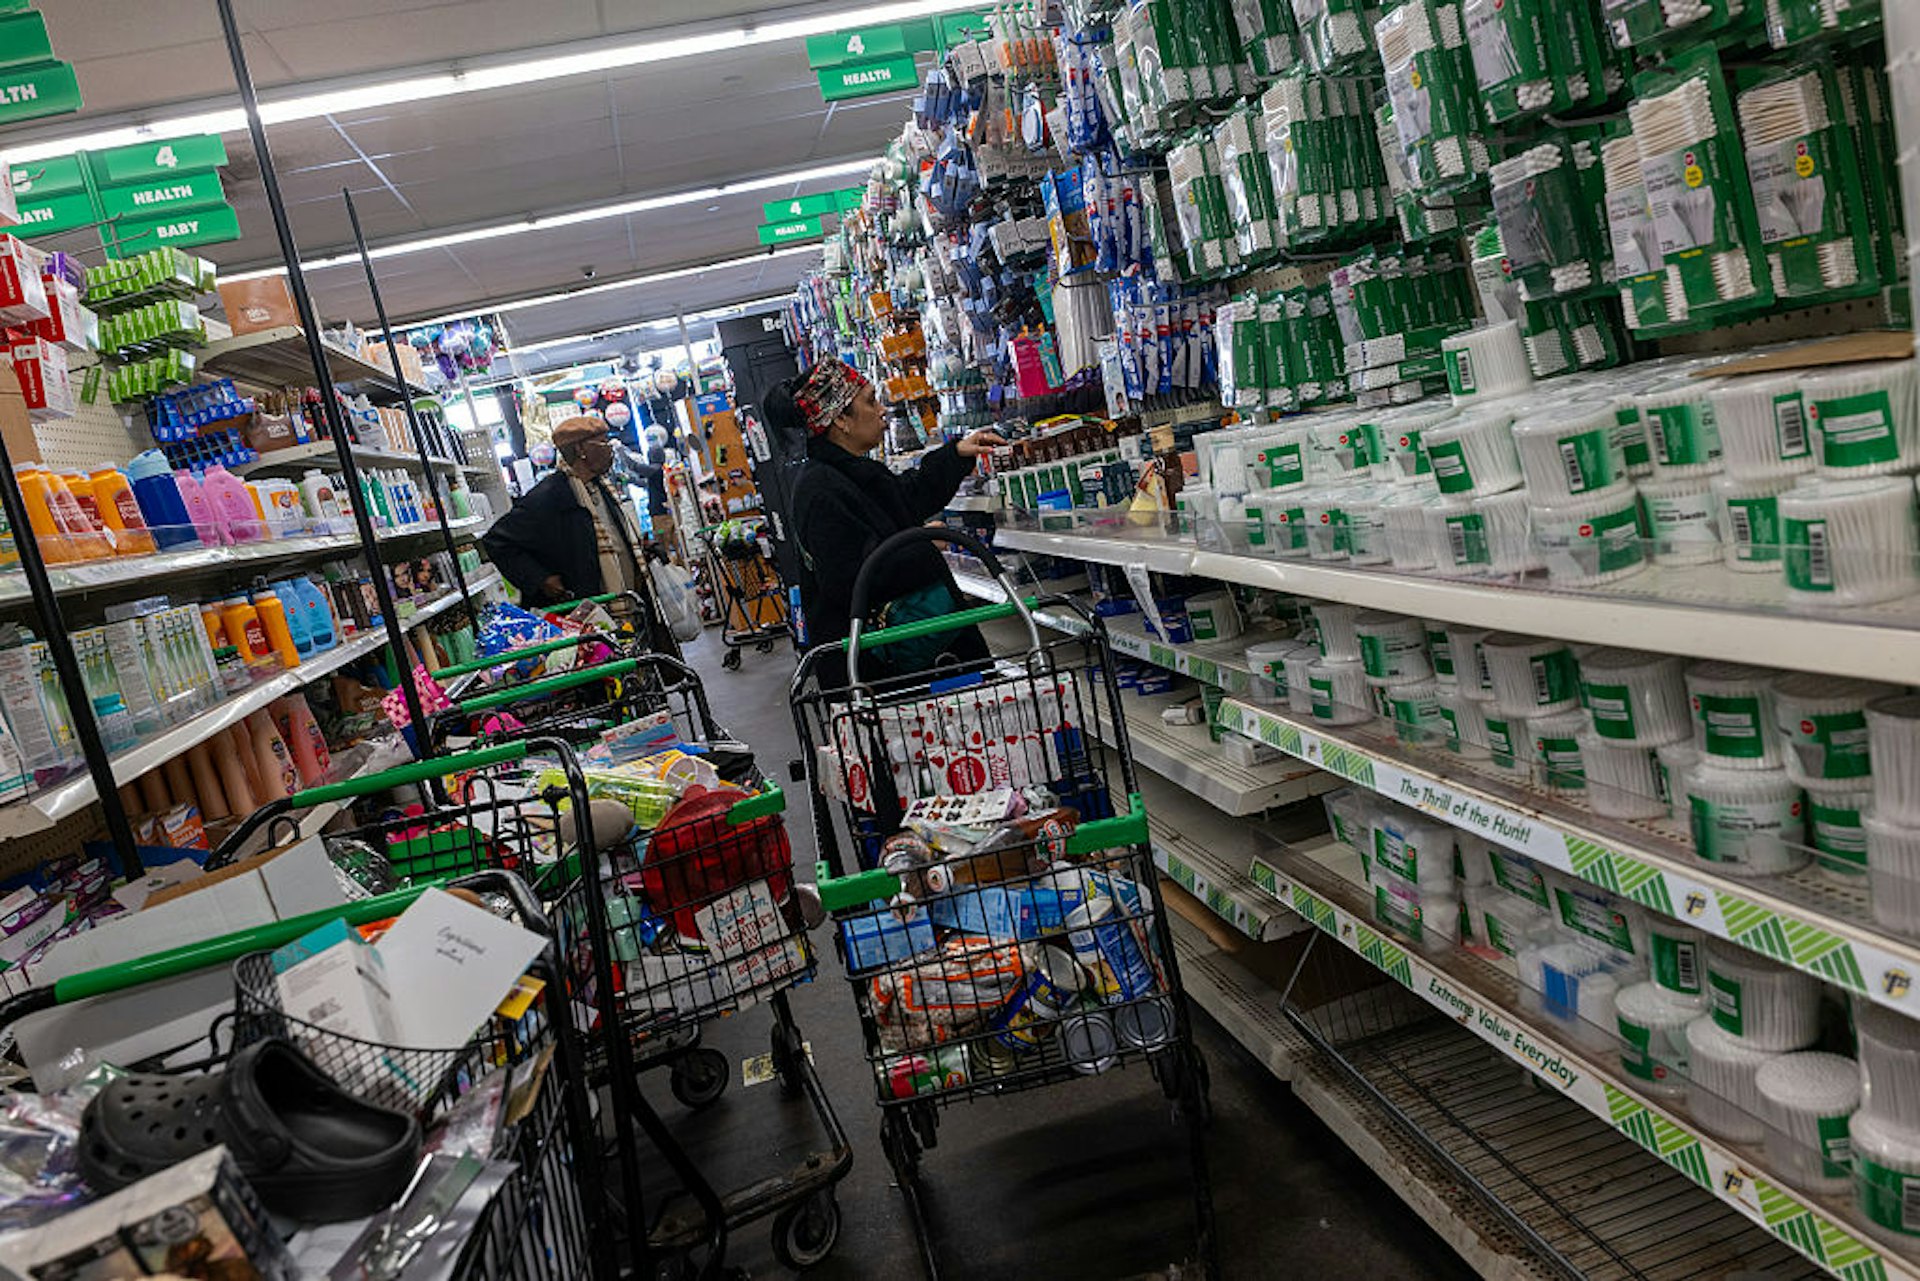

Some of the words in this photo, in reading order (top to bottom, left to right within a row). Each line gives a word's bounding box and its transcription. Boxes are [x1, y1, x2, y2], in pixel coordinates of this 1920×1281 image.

[847, 34, 865, 55] 4
[842, 67, 892, 86] HEALTH
[155, 146, 179, 168] 4
[12, 170, 32, 193] 5
[132, 184, 194, 206] HEALTH
[18, 207, 54, 225] ATH
[789, 201, 802, 216] 4
[156, 220, 199, 238] BABY
[774, 223, 808, 237] HEALTH
[1400, 778, 1419, 798] The
[1423, 787, 1452, 811] Thrill
[1453, 800, 1469, 817] of
[1469, 806, 1489, 827] the
[1492, 814, 1531, 844] Hunt!
[1428, 978, 1475, 1017] Extreme
[1479, 1009, 1512, 1042] Value
[1513, 1032, 1579, 1090] Everyday
